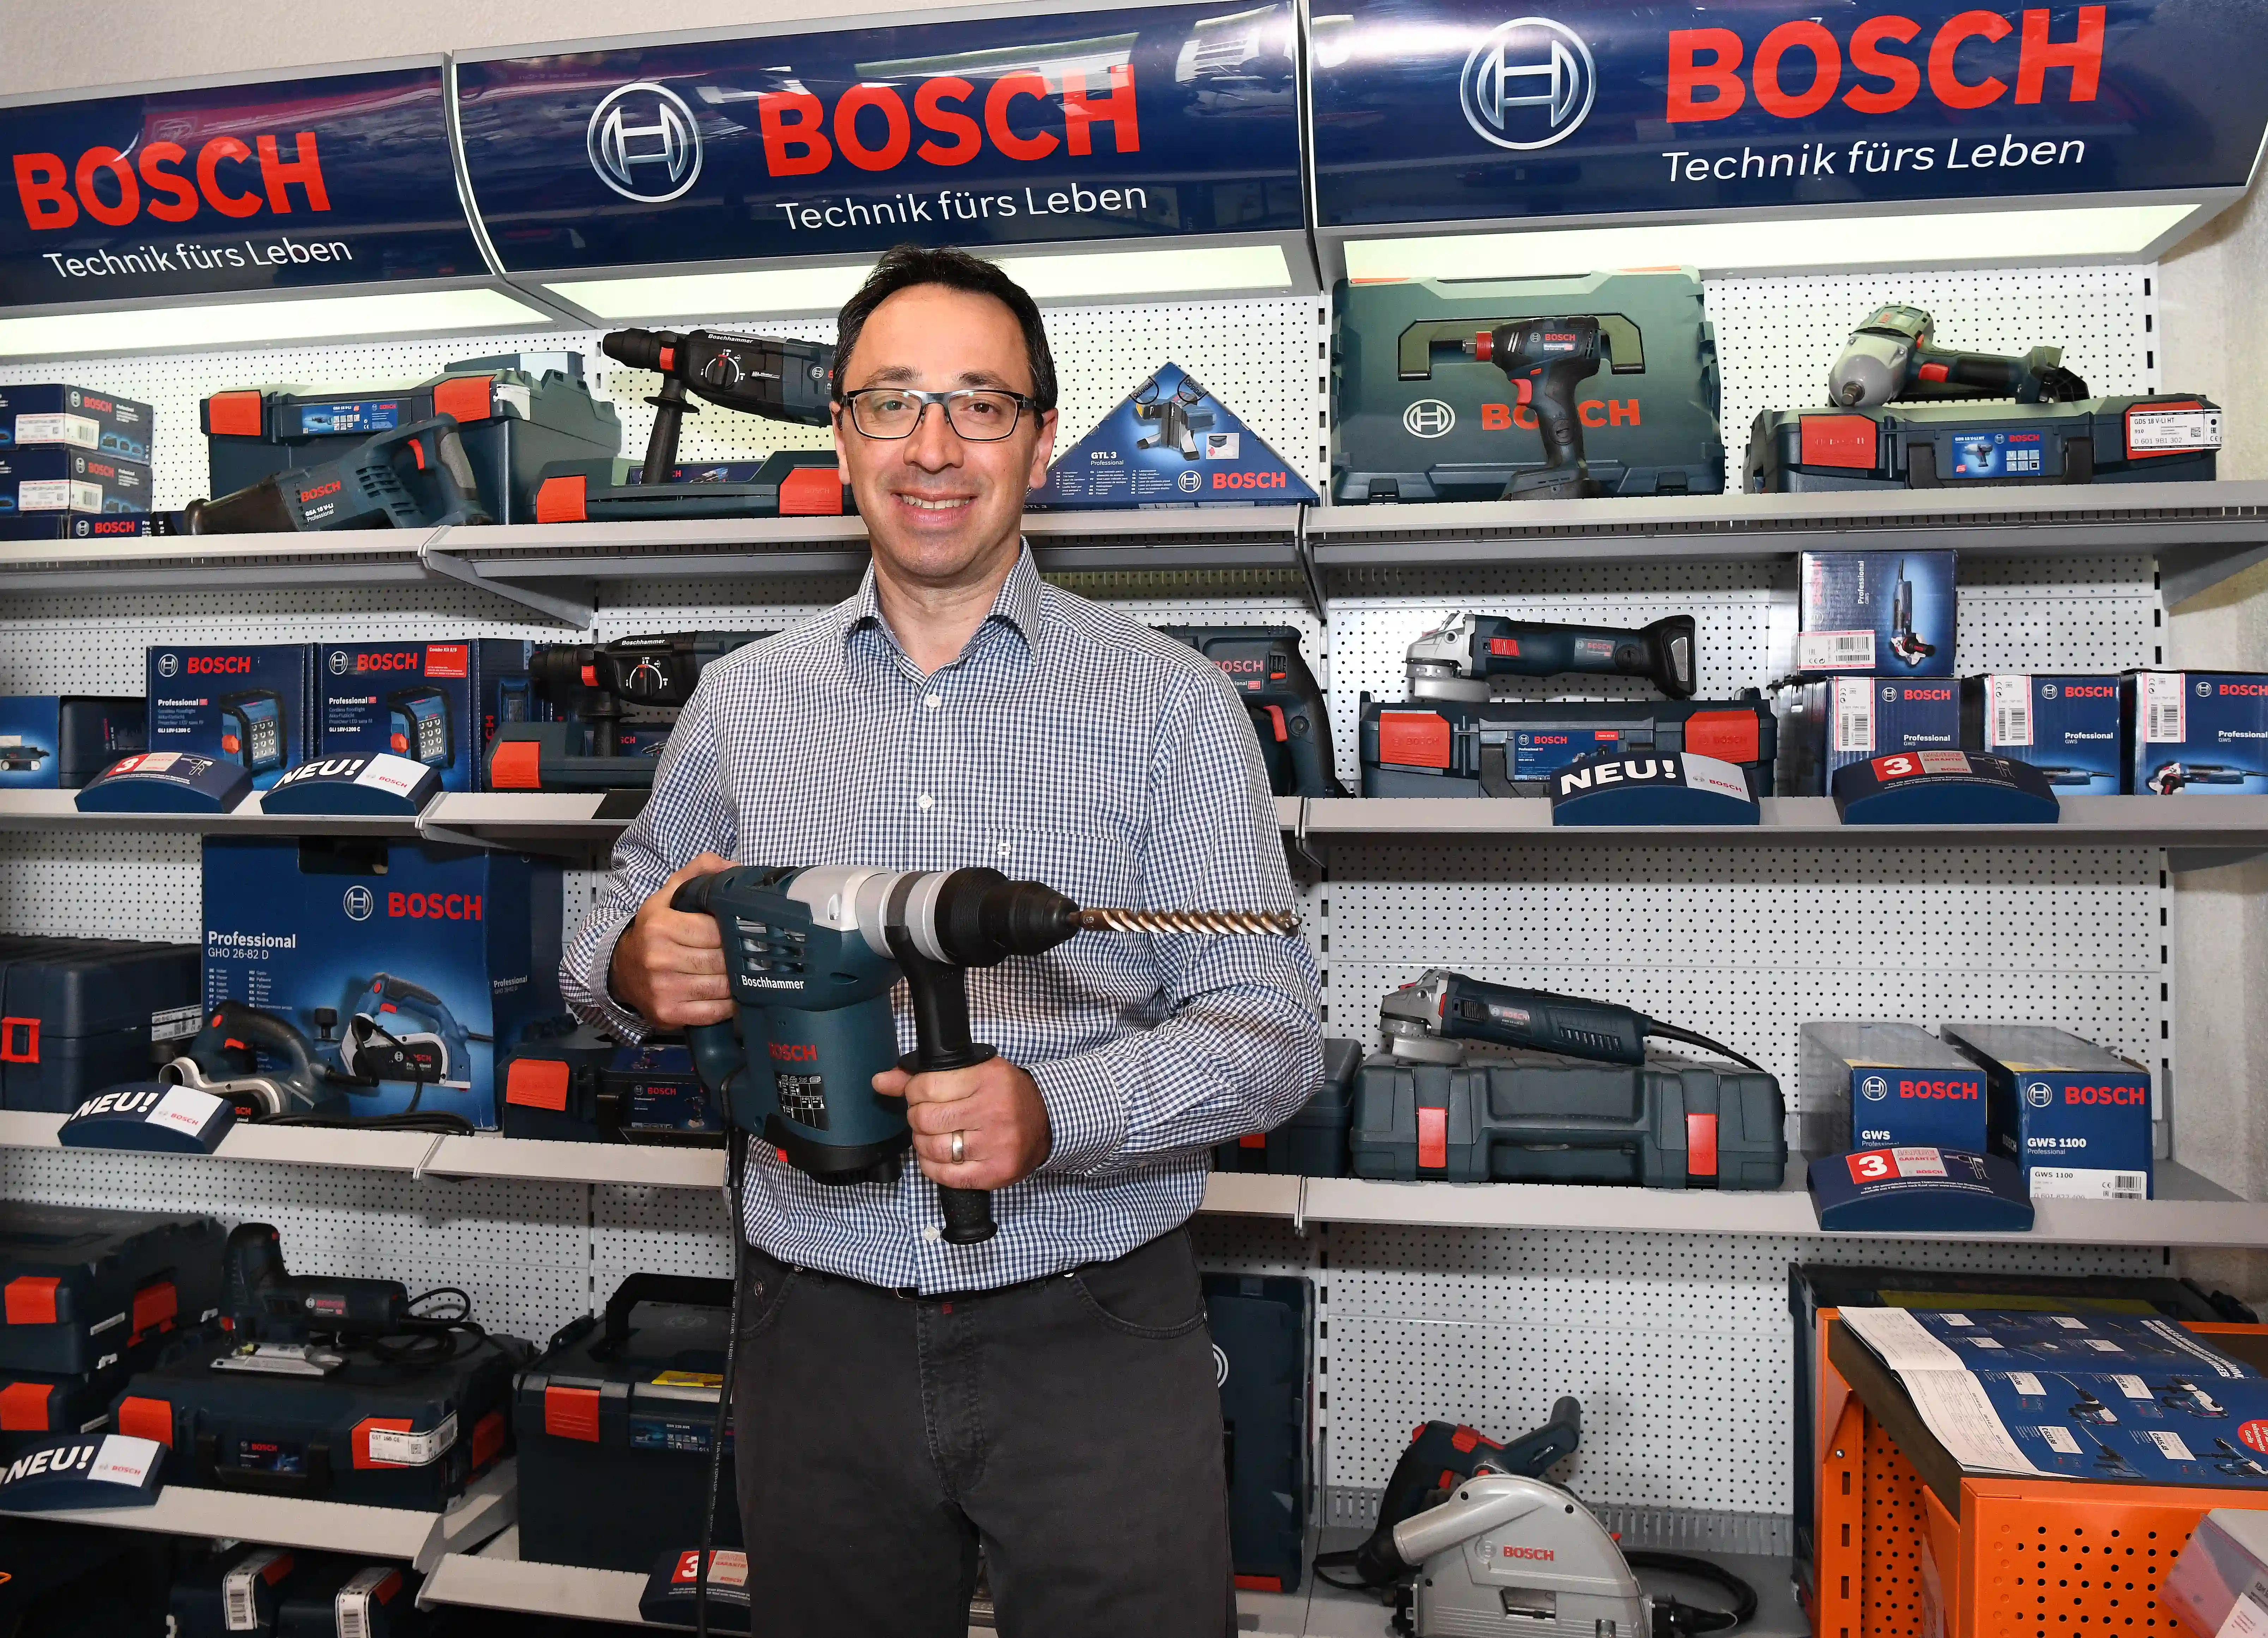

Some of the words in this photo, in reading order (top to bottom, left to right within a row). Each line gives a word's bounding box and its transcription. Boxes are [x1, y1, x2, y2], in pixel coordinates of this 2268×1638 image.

[1667, 5, 2106, 123] BOSCH
[758, 65, 1140, 177] BOSCH
[1662, 143, 1836, 182] Technik
[1848, 140, 1935, 173] fürs
[1947, 134, 2085, 168] Leben
[13, 132, 331, 230] BOSCH
[775, 193, 932, 229] Technik
[938, 191, 1016, 220] fürs
[1026, 183, 1147, 215] Leben
[42, 246, 175, 277] Technik
[176, 243, 245, 270] fürs
[245, 237, 352, 265] Leben
[708, 333, 754, 344] Boschhammer
[1132, 380, 1154, 399] Original
[1184, 379, 1204, 397] Original
[84, 397, 112, 412] BOSCH
[1481, 399, 1640, 430] BOCH
[88, 462, 114, 477] BOSCH
[1213, 472, 1286, 489] BOSCH
[301, 481, 341, 502] BOSCH
[306, 508, 334, 522] Professional
[95, 521, 135, 533] BOSCH
[188, 657, 250, 673] BOSCH
[357, 653, 418, 671] BOSCH
[1904, 690, 1951, 700] BOSCH
[2065, 687, 2113, 697] BOSCH
[2219, 684, 2268, 696] BOSCH
[329, 696, 368, 705] Professional
[2065, 732, 2113, 741] Professional
[115, 757, 139, 773] 3
[1883, 757, 1912, 775] 3
[272, 759, 366, 790] NEU!
[379, 776, 407, 788] BOSCH
[1561, 757, 1676, 795] NEU!
[1709, 779, 1742, 791] BOSCH
[388, 893, 481, 920] BOSCH
[208, 931, 296, 949] Professional
[208, 947, 230, 958] GHO
[233, 948, 258, 959] 26-82
[262, 950, 268, 960] D
[494, 974, 528, 988] Professional
[741, 975, 804, 989] Boschhammer
[768, 1041, 818, 1062] BOSCH
[1900, 1081, 1977, 1099] BOSCH
[2066, 1087, 2144, 1105] BOSCH
[69, 1092, 159, 1121] NEU!
[235, 1107, 252, 1115] SCH
[171, 1113, 199, 1125] BOSCH
[1862, 1130, 1890, 1140] GWS
[2027, 1138, 2056, 1147] GWS
[2059, 1138, 2086, 1148] 1100
[1858, 1155, 1887, 1176] 3
[2244, 1430, 2254, 1444] Geräte
[2251, 1423, 2266, 1452] teilnehmenden
[5, 1446, 93, 1482] NEU!
[111, 1465, 141, 1475] BOSCH
[1503, 1546, 1554, 1561] BOSCH
[682, 1555, 699, 1577] 3
